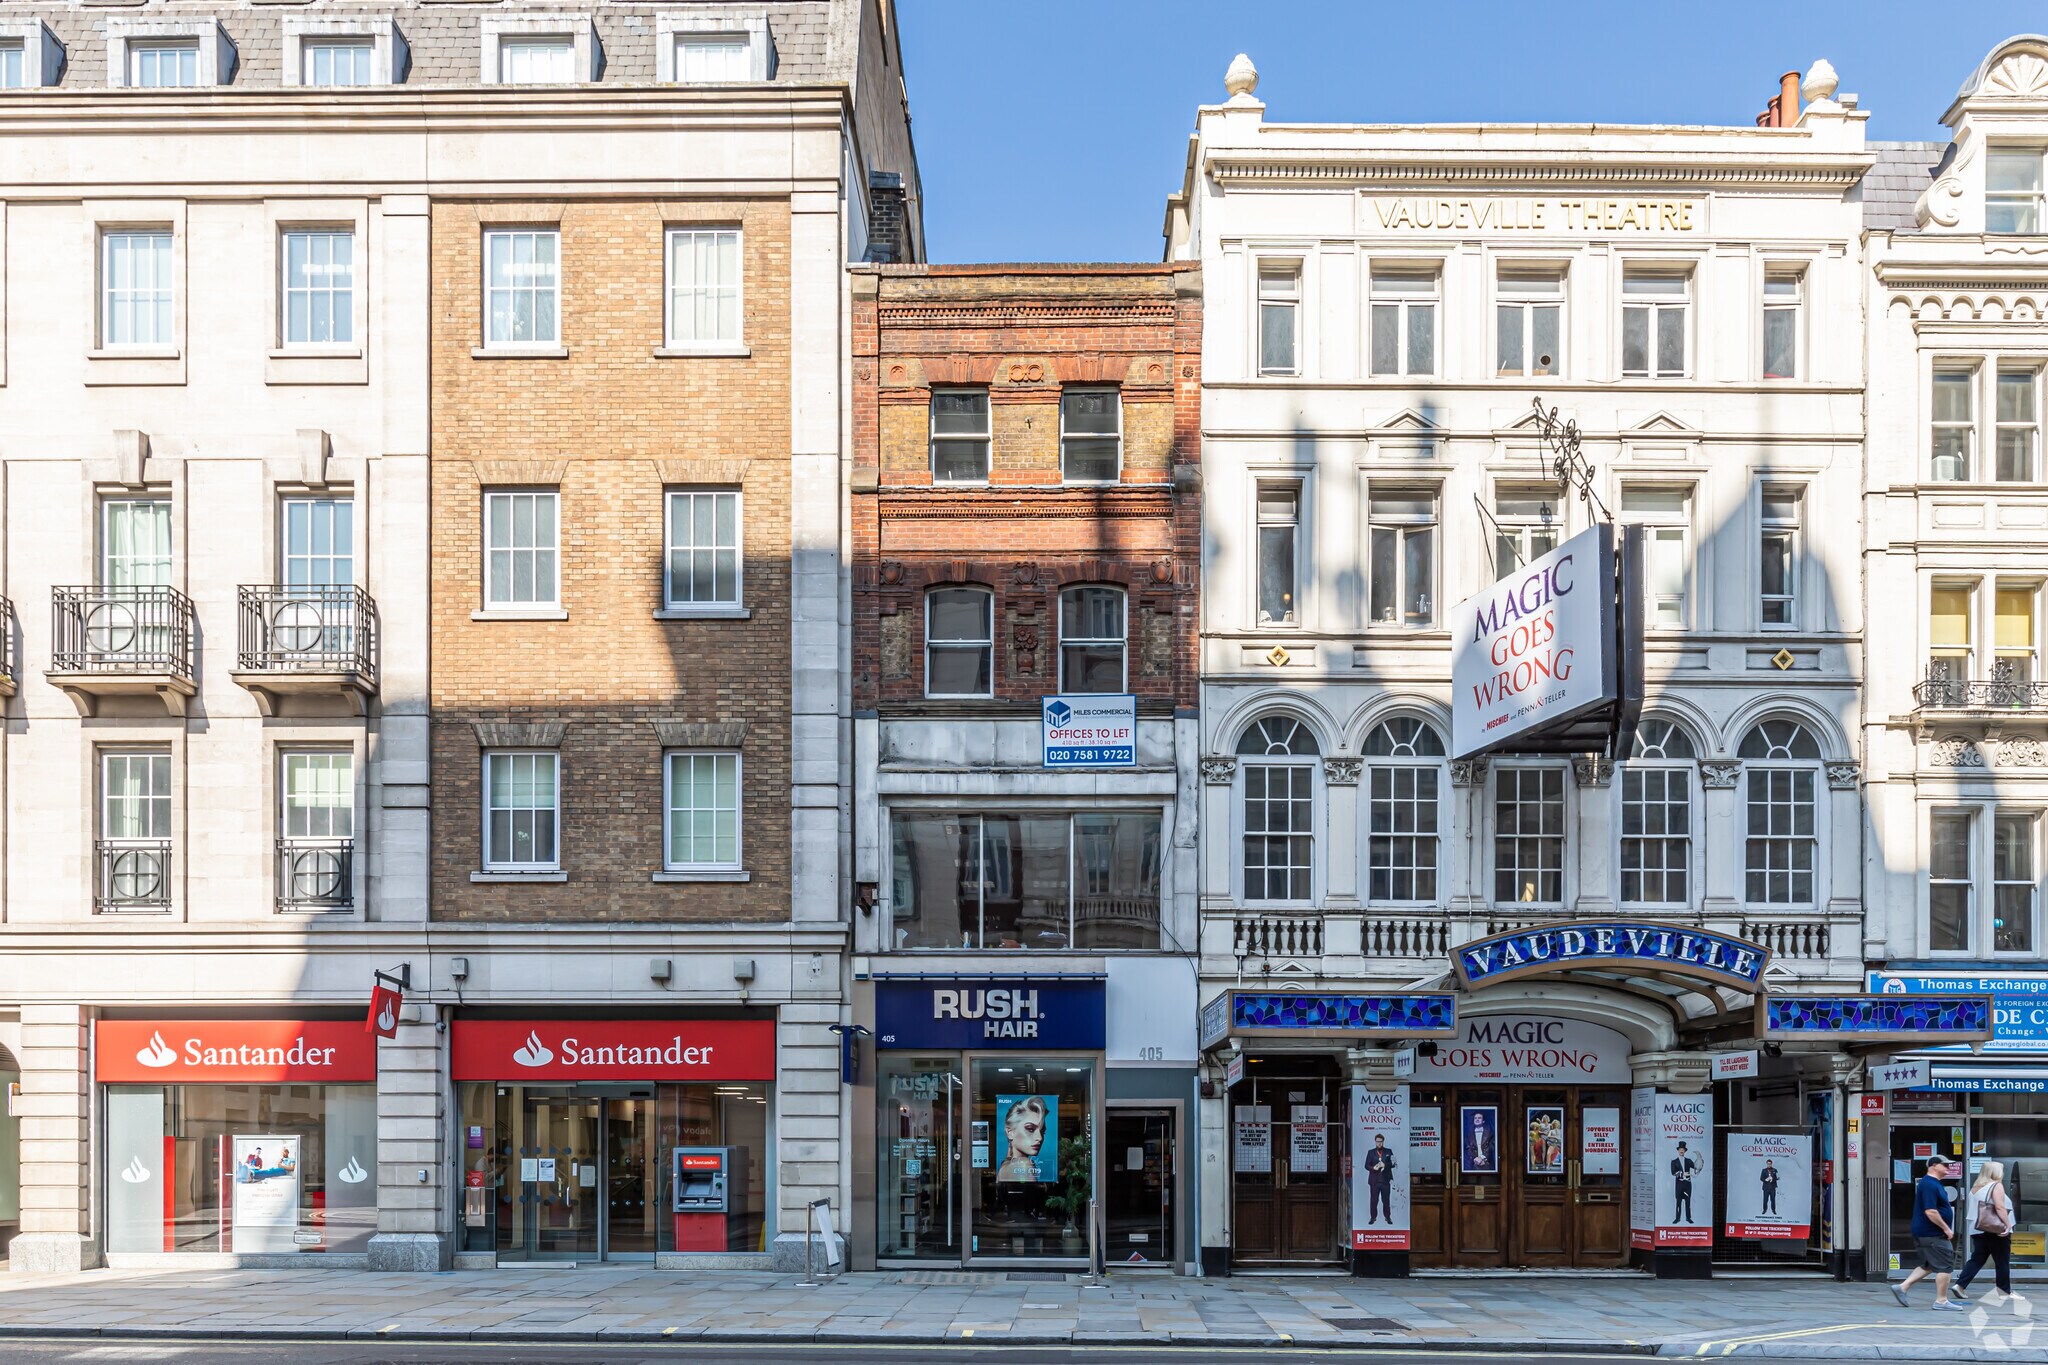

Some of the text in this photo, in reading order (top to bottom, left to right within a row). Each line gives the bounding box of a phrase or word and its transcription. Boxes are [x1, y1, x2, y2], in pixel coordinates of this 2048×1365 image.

[1373, 199, 1693, 231] VAUDEVILLE THEATRE
[1472, 554, 1574, 645] MAGIC
[1490, 609, 1554, 667] GOES
[1472, 648, 1574, 711] WRONG
[1091, 708, 1133, 716] COMMERCIAL
[1486, 712, 1510, 731] MISCHIEF
[1517, 703, 1535, 717] PENN
[1544, 689, 1567, 705] TELLER
[1049, 728, 1130, 739] OFFICES TO LET
[1049, 749, 1130, 760] 020 7581 9722
[1467, 928, 1757, 977] VAUDEVILLE
[1918, 978, 1973, 990] Thomas
[1979, 978, 2047, 993] Exchange
[933, 988, 1038, 1019] RUSH
[1993, 1008, 2048, 1025] DE C
[983, 1020, 1038, 1038] HAIR
[1466, 1020, 1564, 1044] MAGIC
[1997, 1026, 2035, 1036] Change
[881, 1034, 896, 1043] 405
[184, 1036, 336, 1066] Santander
[561, 1035, 714, 1065] Santander
[1138, 1046, 1164, 1061] 405
[1429, 1048, 1599, 1073] GOES WRONG
[1931, 1078, 2045, 1092] Thomas Exchange
[1360, 1094, 1403, 1105] MAGIC
[1867, 1098, 1878, 1108] 0%
[1367, 1105, 1395, 1115] GOES
[1663, 1103, 1706, 1114] MAGIC
[1359, 1114, 1402, 1126] WRONG
[1670, 1114, 1698, 1123] GOES
[1662, 1123, 1705, 1135] WRONG
[1753, 1136, 1787, 1146] MAGIC
[1741, 1145, 1763, 1153] GOES
[1765, 1145, 1798, 1156] WRONG
